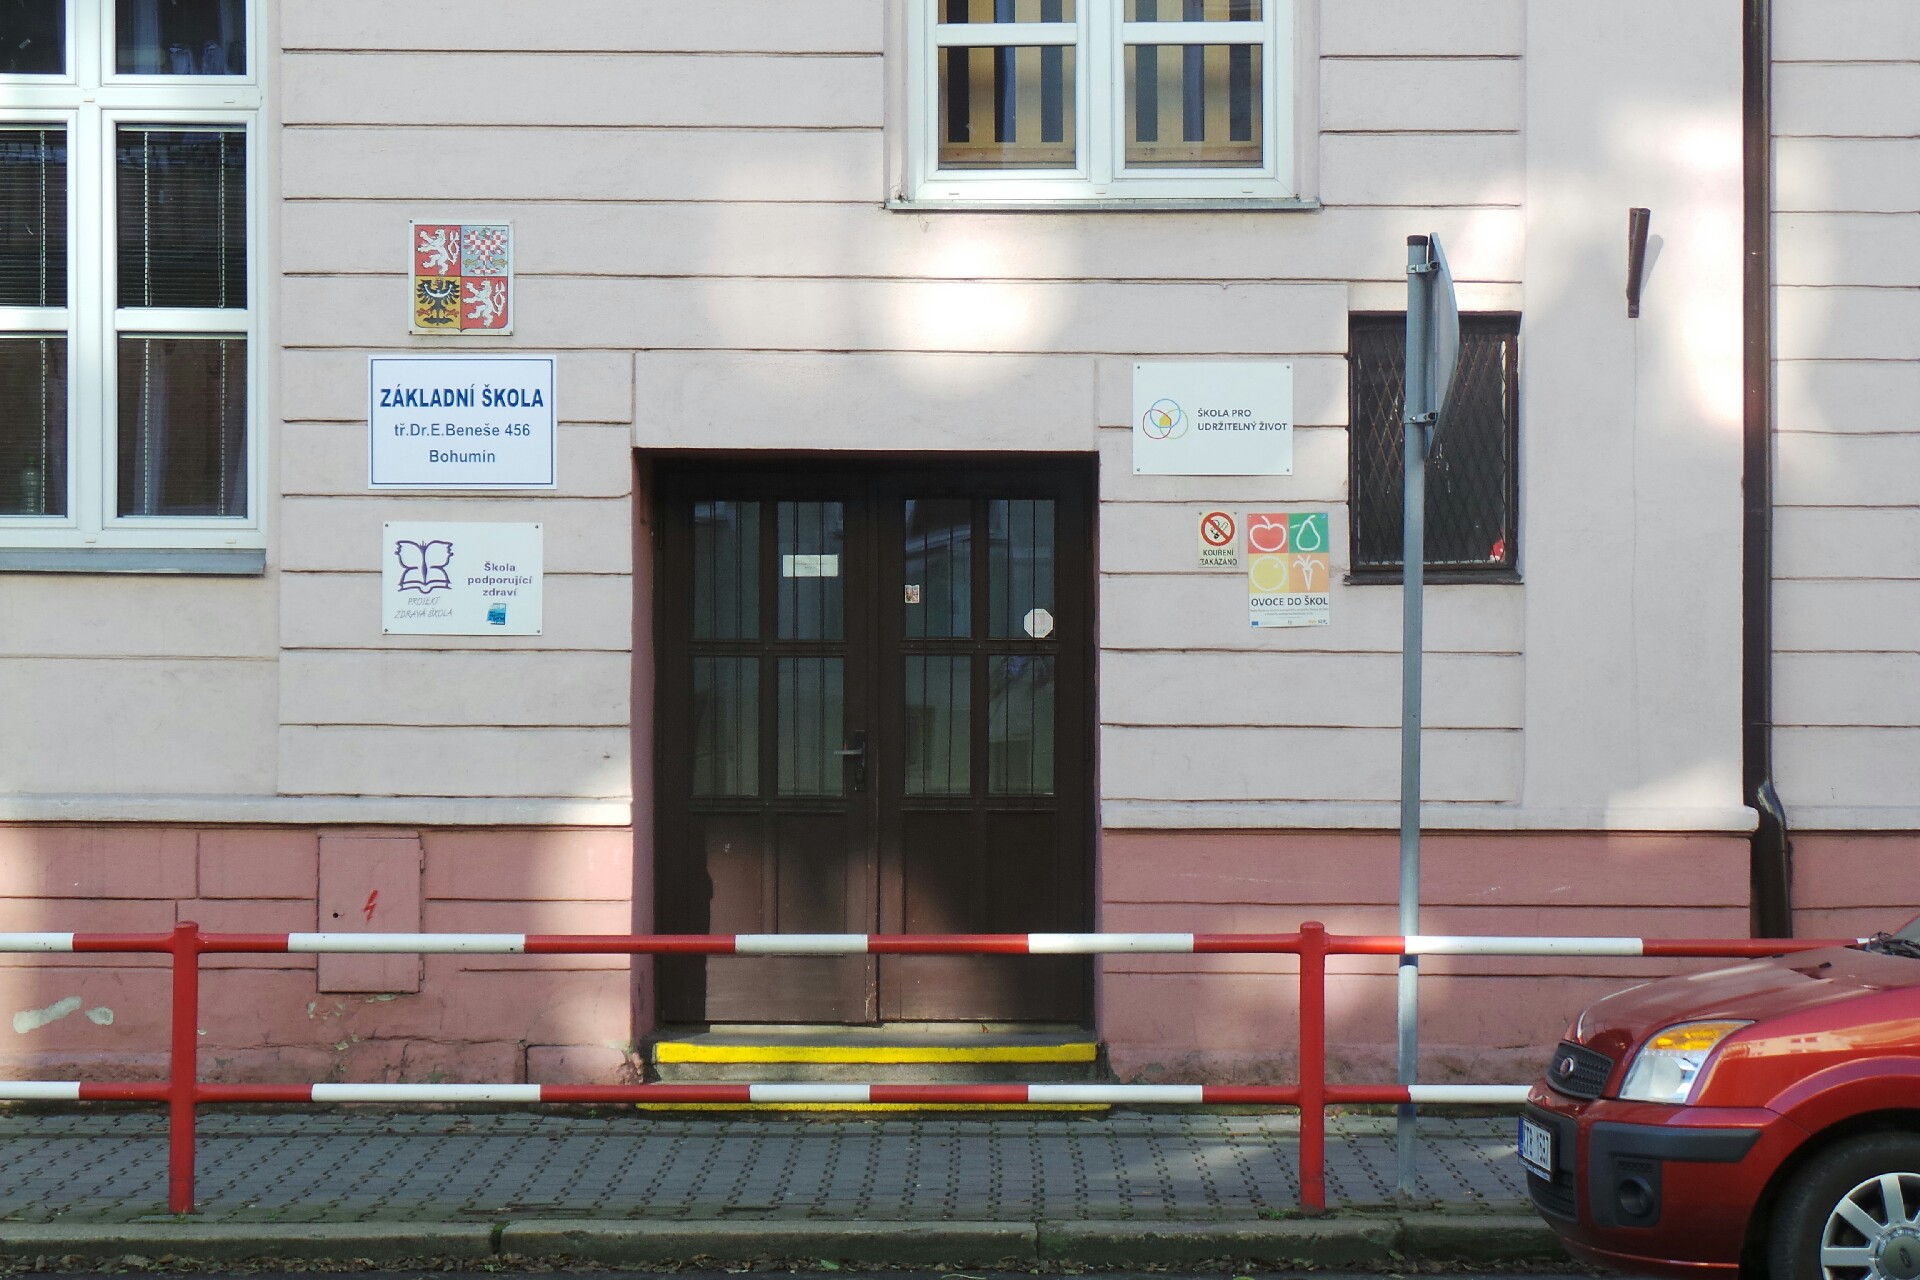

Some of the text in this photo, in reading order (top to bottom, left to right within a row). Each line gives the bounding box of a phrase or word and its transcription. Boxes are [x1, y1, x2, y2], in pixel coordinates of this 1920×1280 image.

[380, 384, 544, 407] ZÁKLADNÍ ŠKOLA
[1197, 407, 1252, 417] ŠKOLA PRO
[394, 423, 530, 437] tř.Dr.E.Beneše 456
[1197, 421, 1288, 431] UDRŽITELNÝ ŽIVOT
[429, 449, 496, 463] Bohumín
[1202, 548, 1234, 556] KOUŘENÍ
[483, 560, 516, 572] Škola
[467, 575, 533, 585] podporující
[482, 587, 518, 597] zdraví
[407, 596, 440, 606] PROJEKT
[1251, 595, 1328, 607] OVOCE DO ŠKOL
[427, 607, 453, 618] ŠKOLA
